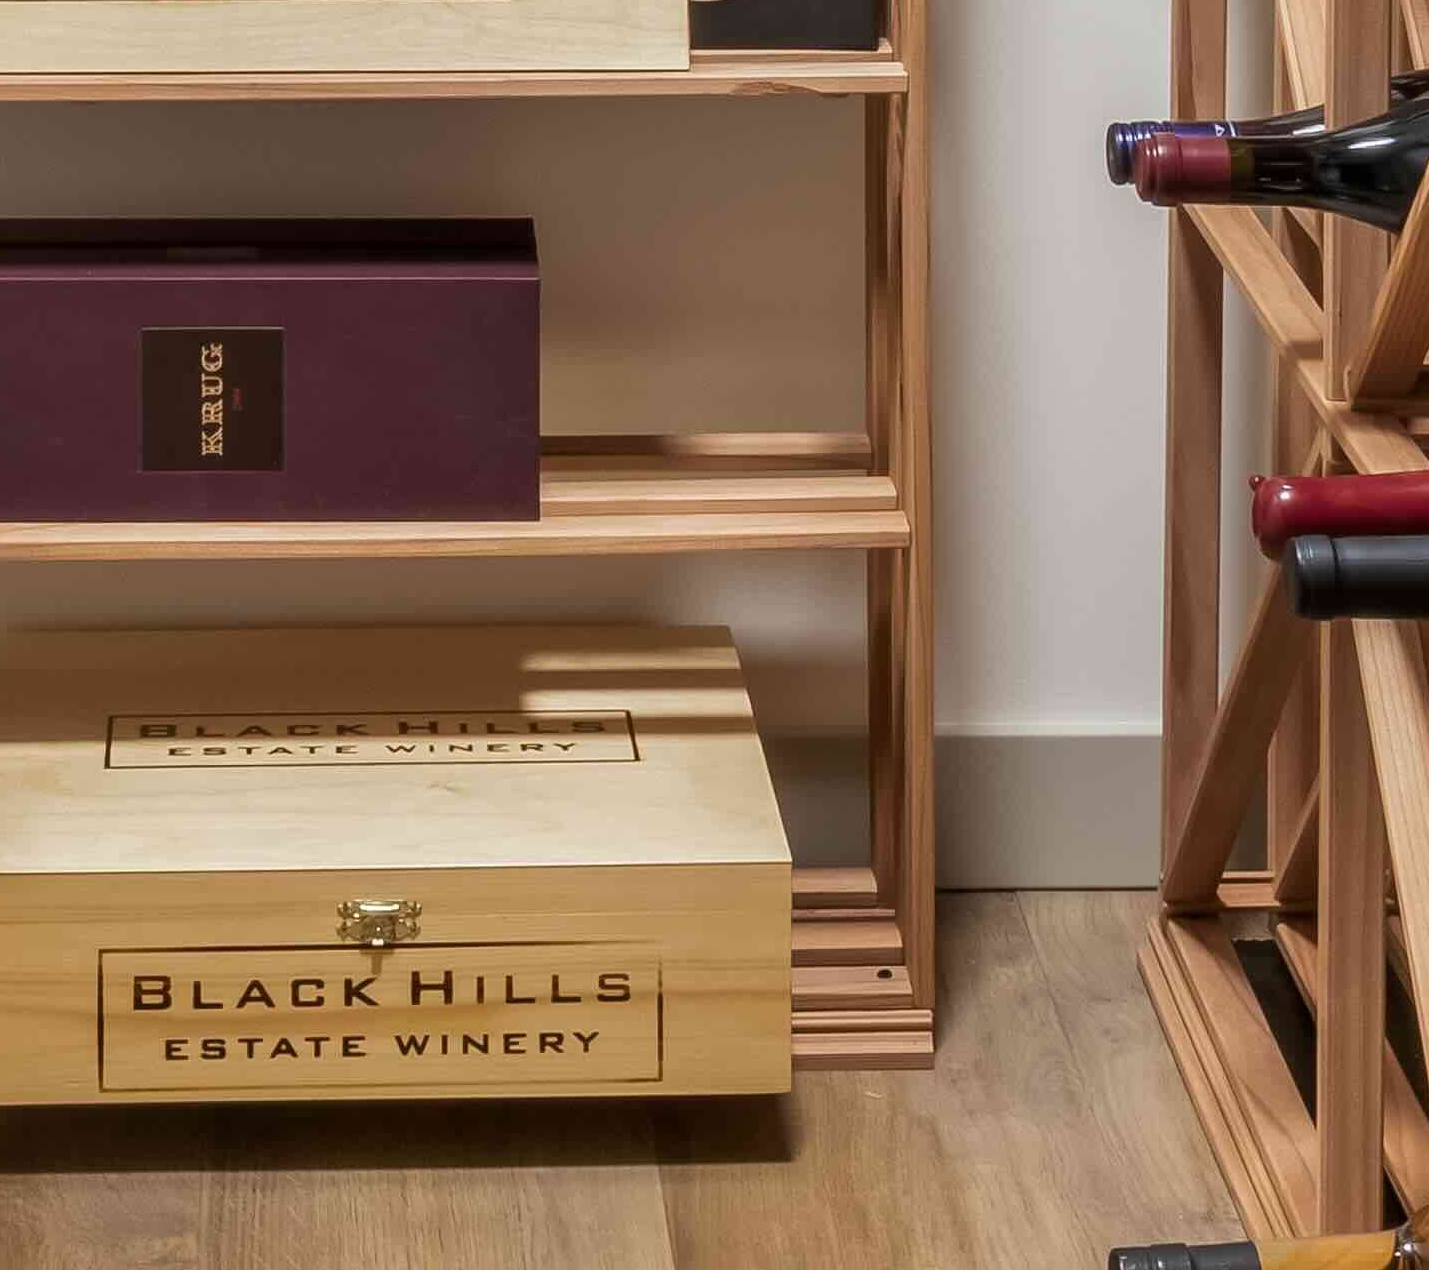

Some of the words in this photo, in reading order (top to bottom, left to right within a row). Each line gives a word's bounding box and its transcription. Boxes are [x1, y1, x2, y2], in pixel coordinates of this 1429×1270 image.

[201, 343, 223, 456] KRUG
[138, 720, 382, 740] BLACK
[396, 718, 609, 738] HILLS
[168, 745, 358, 756] ESTATE
[385, 742, 577, 754] WINERY
[133, 972, 380, 1012] BLACK
[410, 970, 633, 1007] HILLS
[165, 1035, 368, 1061] ESTATE
[394, 1031, 601, 1057] WINERY
